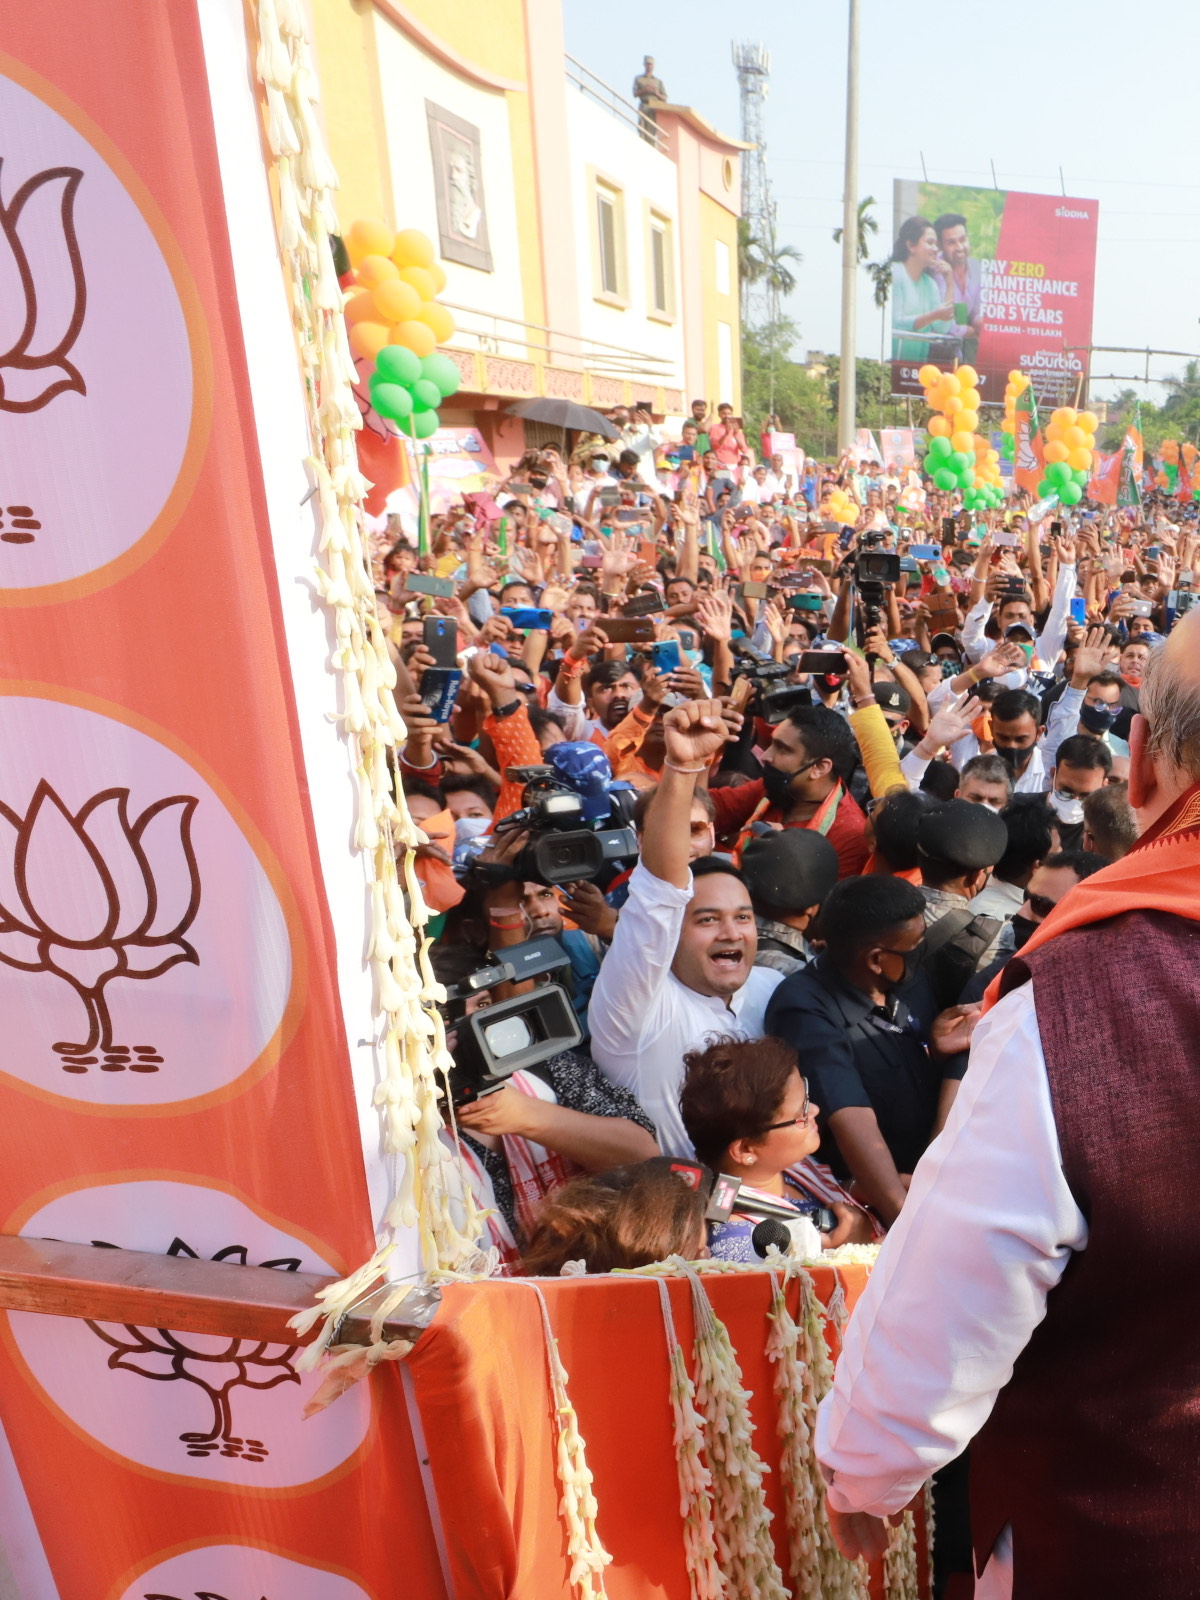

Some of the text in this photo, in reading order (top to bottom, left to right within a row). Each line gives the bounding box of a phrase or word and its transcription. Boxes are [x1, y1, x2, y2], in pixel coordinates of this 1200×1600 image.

[980, 259, 1045, 278] PAY ZERO
[980, 274, 1078, 297] MAINTENANCE
[980, 290, 1042, 307] CHARGES
[979, 305, 1063, 325] FOR 5 YEARS
[999, 326, 1021, 335] LAKH
[1040, 328, 1063, 338] LAKH
[1019, 350, 1082, 371] suburbia
